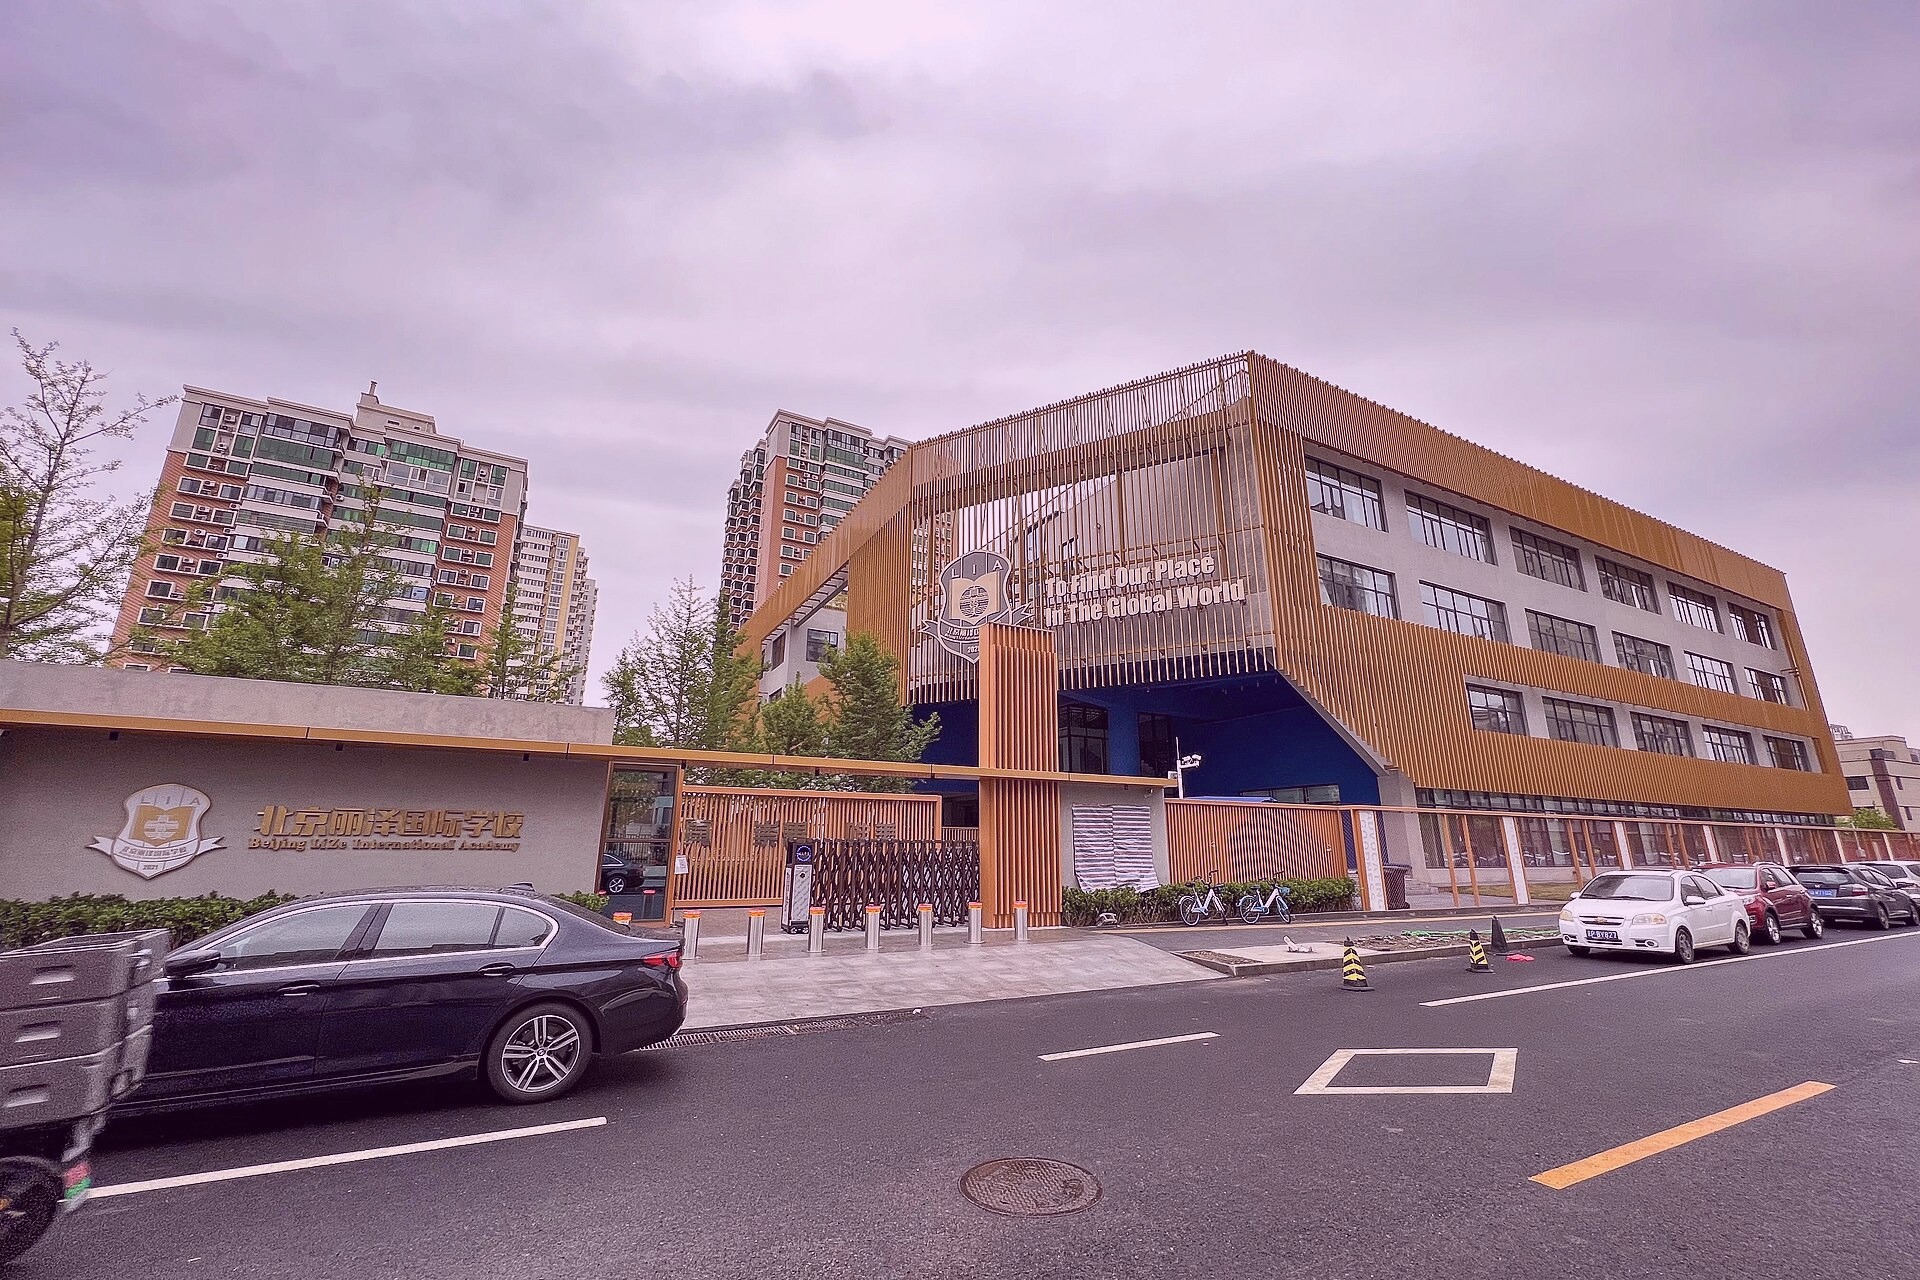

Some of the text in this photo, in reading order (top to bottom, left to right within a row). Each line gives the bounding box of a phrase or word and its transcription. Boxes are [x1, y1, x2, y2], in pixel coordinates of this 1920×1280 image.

[1046, 555, 1215, 598] To Find Our Place
[1046, 578, 1246, 628] In The Global World
[967, 645, 979, 654] 202
[254, 805, 524, 838] 北京丽泽国际学校
[248, 838, 307, 852] Beijing
[352, 839, 457, 851] International
[458, 840, 520, 852] Academy
